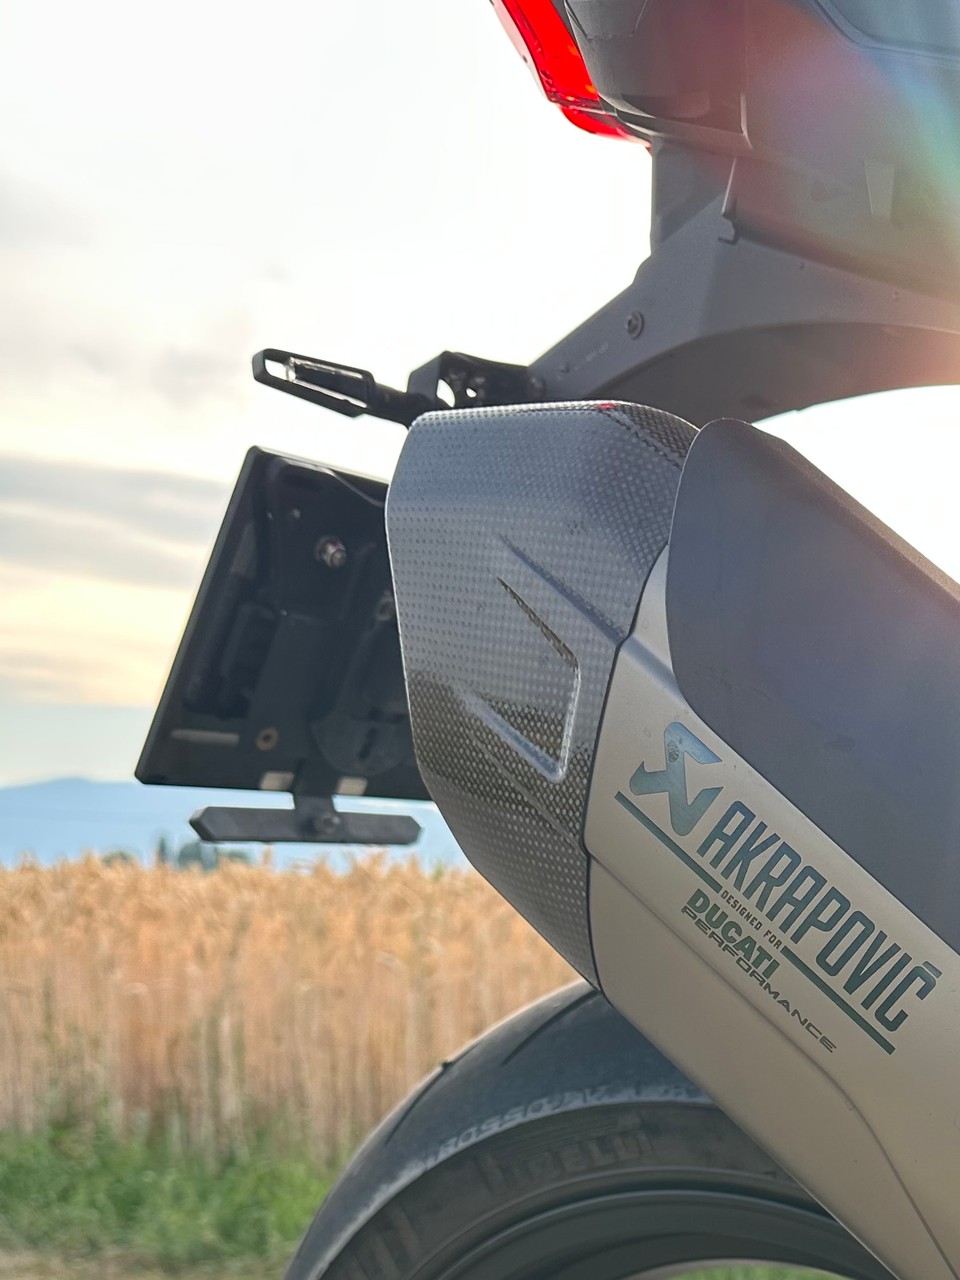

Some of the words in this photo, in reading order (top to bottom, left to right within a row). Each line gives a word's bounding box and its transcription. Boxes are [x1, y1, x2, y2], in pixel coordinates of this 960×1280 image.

[686, 888, 780, 980] DUCATI
[720, 890, 763, 931] DESIGNED
[763, 930, 783, 950] FOR
[680, 905, 838, 1054] PERFORMANCE
